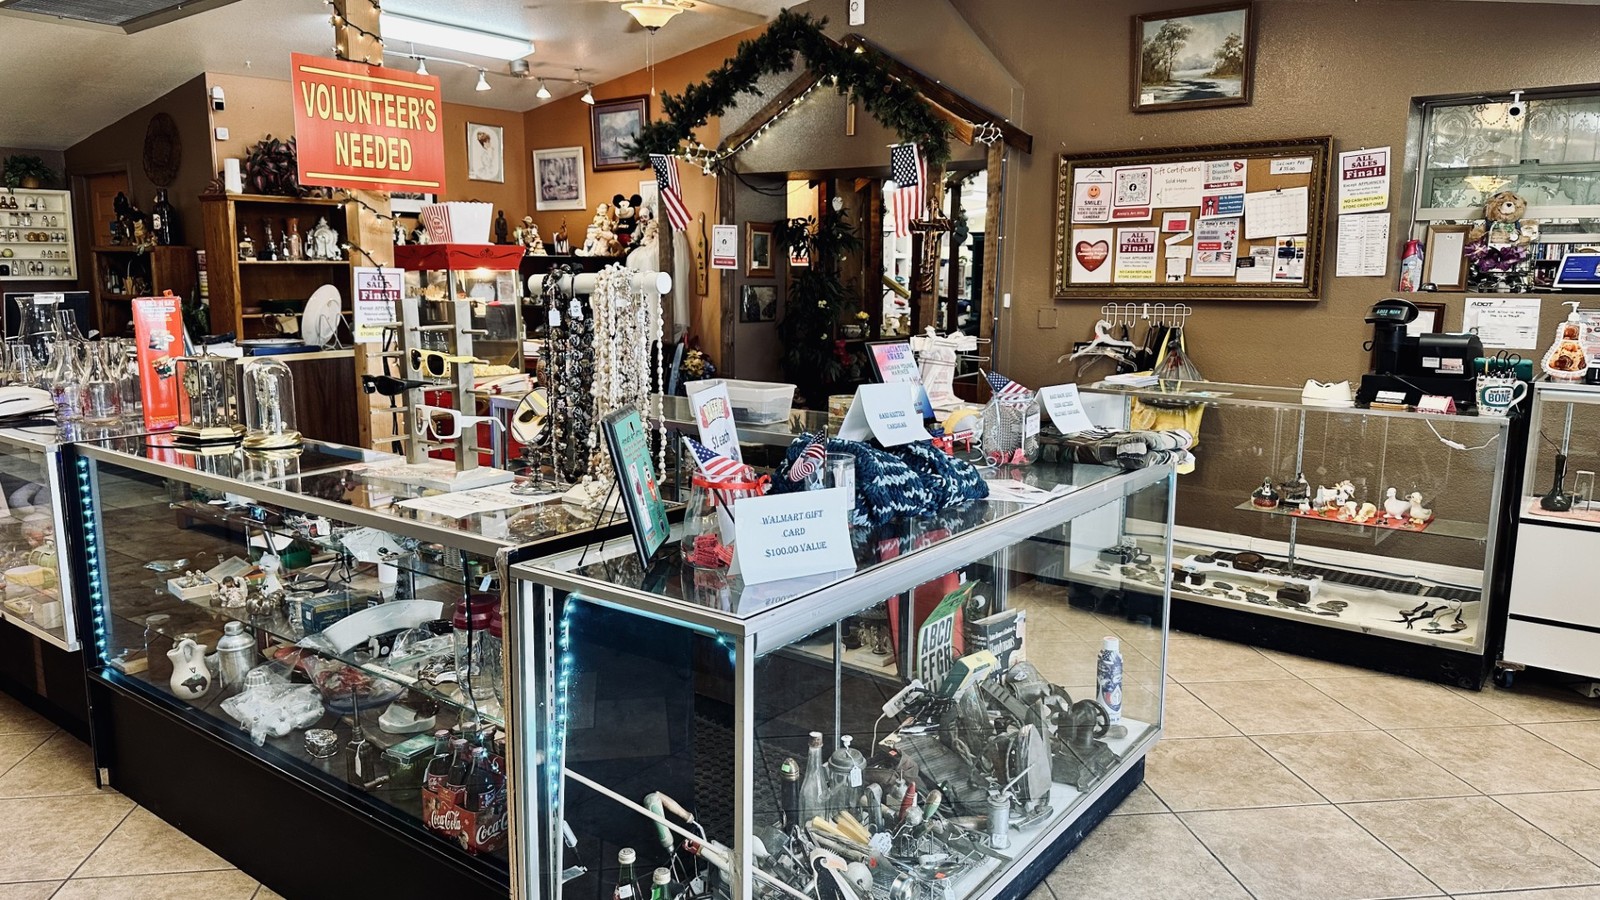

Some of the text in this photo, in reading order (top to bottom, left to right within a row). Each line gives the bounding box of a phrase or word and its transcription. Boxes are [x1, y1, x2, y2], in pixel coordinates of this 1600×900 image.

[300, 81, 437, 133] VOLUNTEER'S
[334, 131, 413, 172] NEEDED
[1351, 160, 1378, 168] SALES
[1153, 167, 1165, 175] Gift
[1345, 167, 1382, 178] Final!
[1122, 244, 1152, 252] Final!
[886, 352, 905, 360] AWARD
[1488, 393, 1510, 402] BONE
[761, 510, 824, 525] WALMART GIFT
[783, 527, 806, 538] CARD
[765, 541, 827, 558] $100.00 VALUE
[921, 616, 953, 656] ABCD
[431, 810, 462, 831] Coca-Cola
